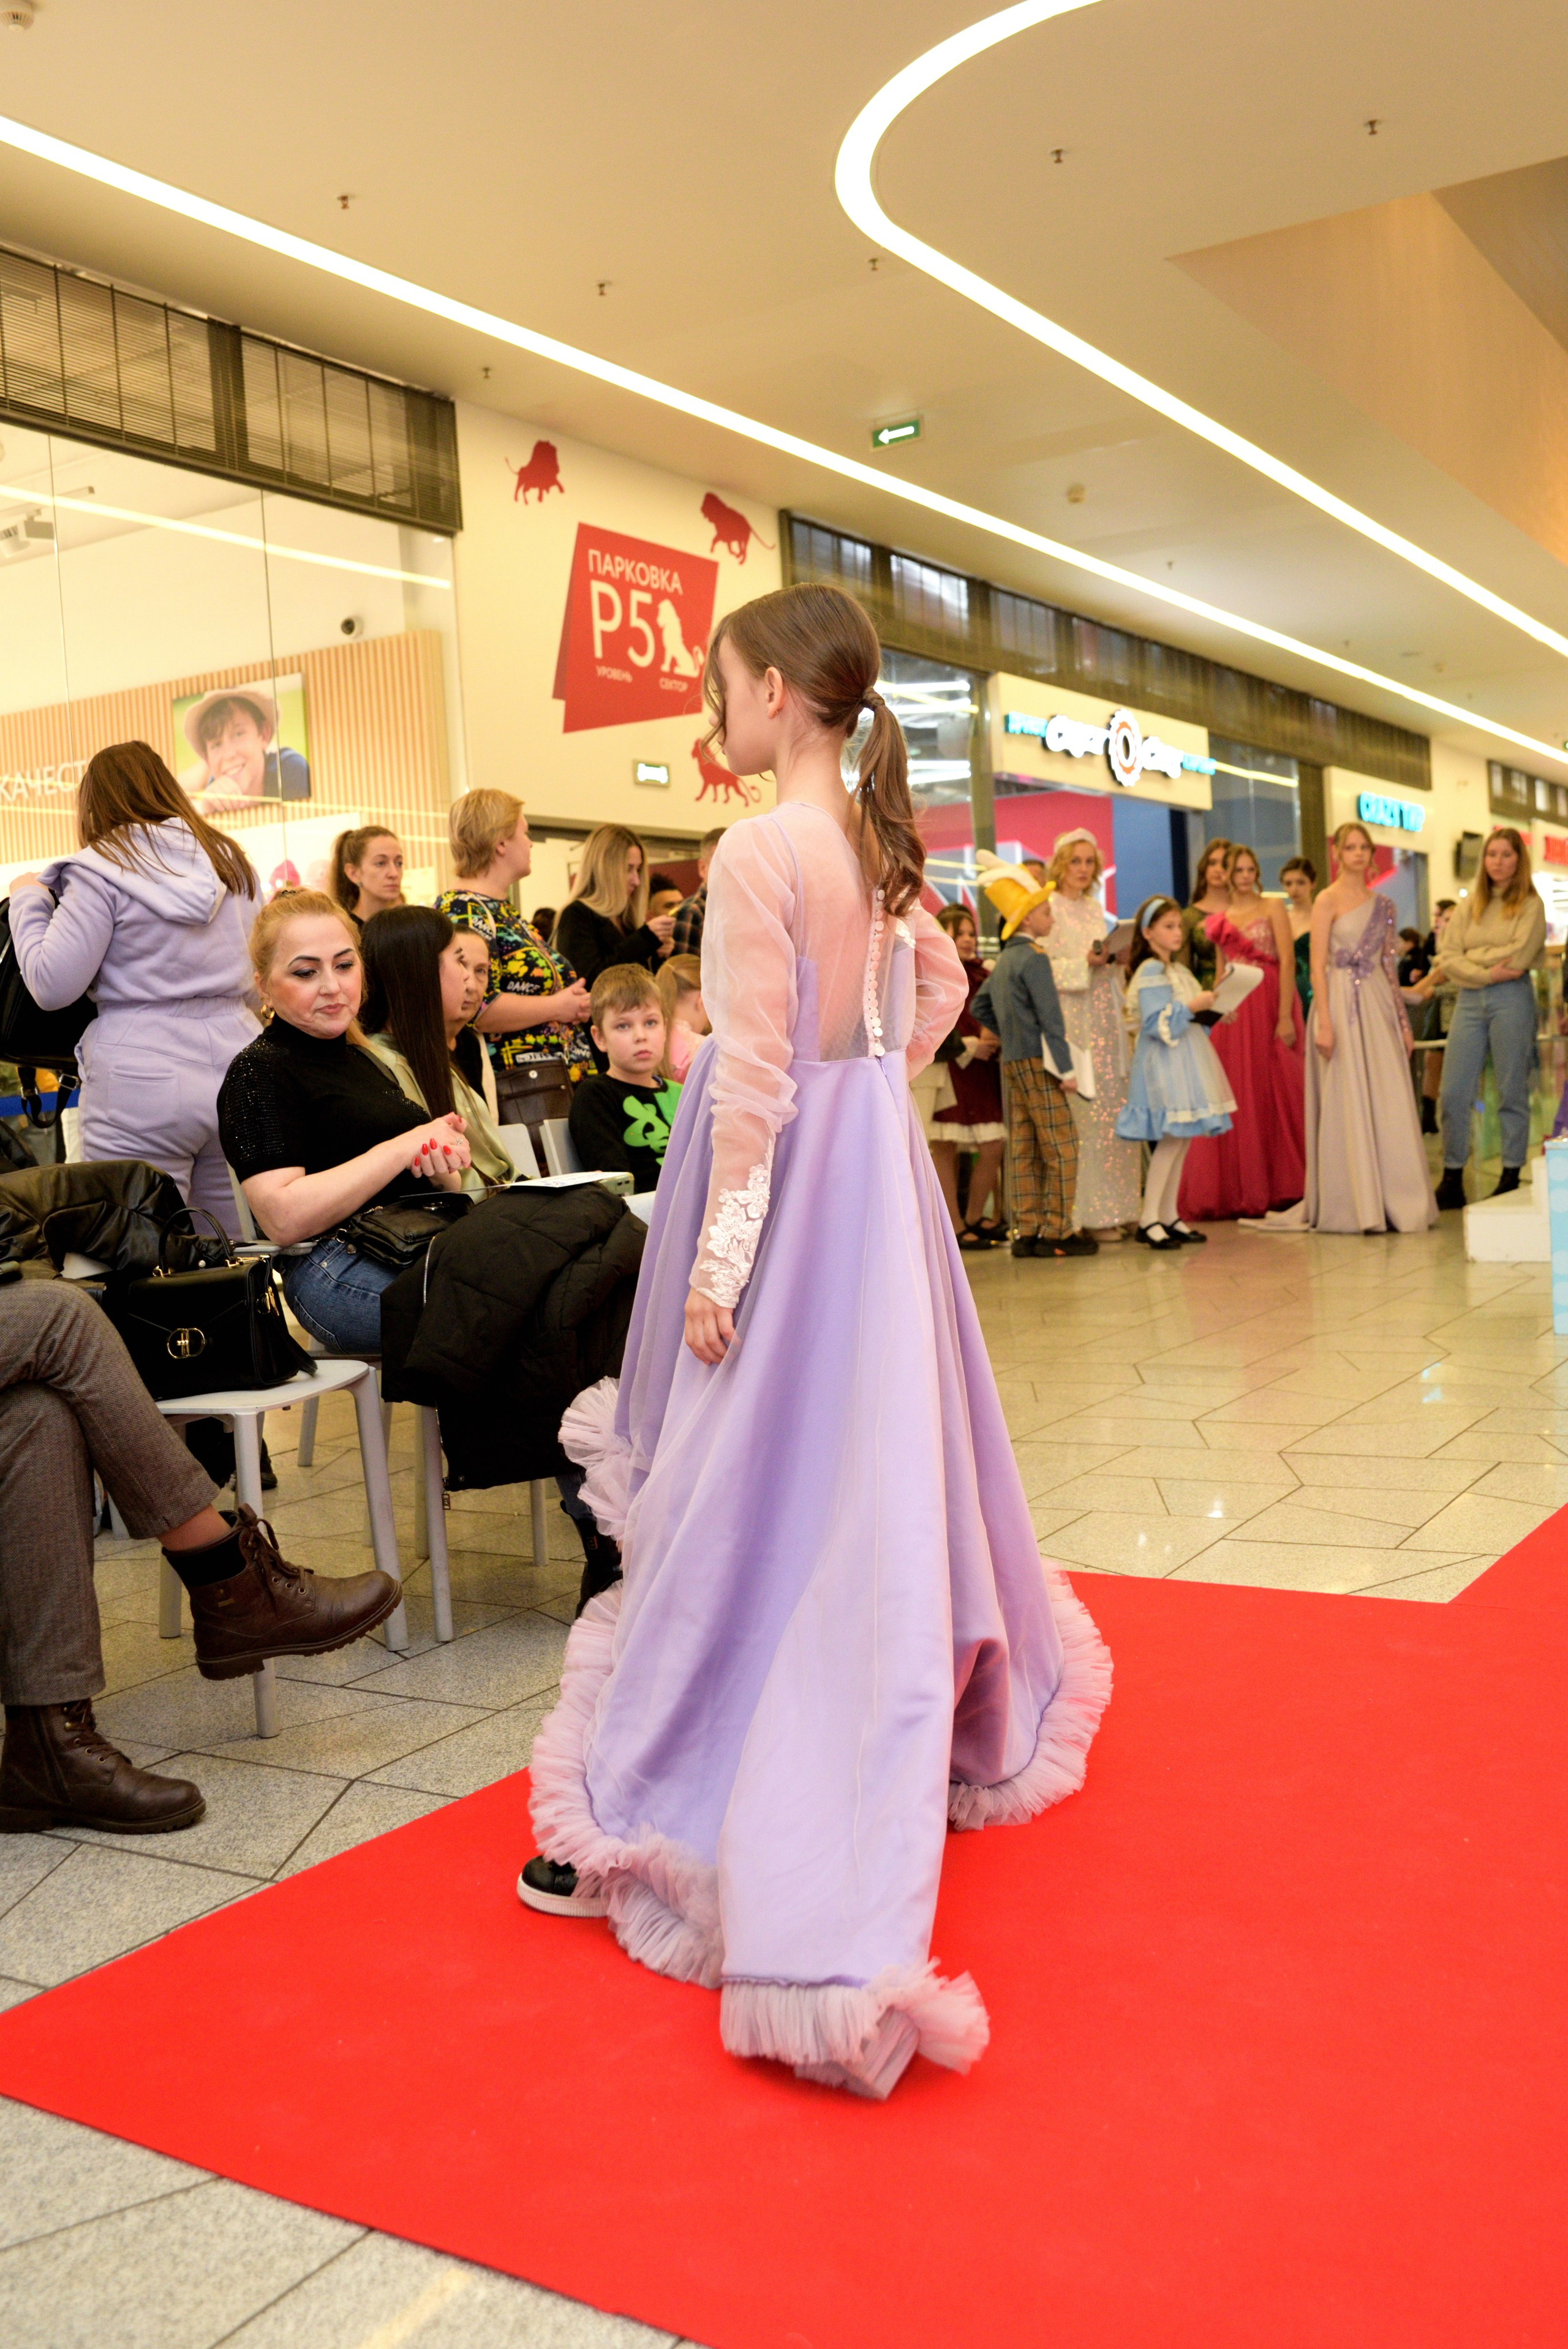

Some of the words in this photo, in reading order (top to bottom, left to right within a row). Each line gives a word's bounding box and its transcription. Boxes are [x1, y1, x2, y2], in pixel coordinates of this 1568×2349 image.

[588, 549, 683, 595] ПАРКОВКА
[590, 579, 655, 668] P5
[507, 981, 540, 994] DANCE
